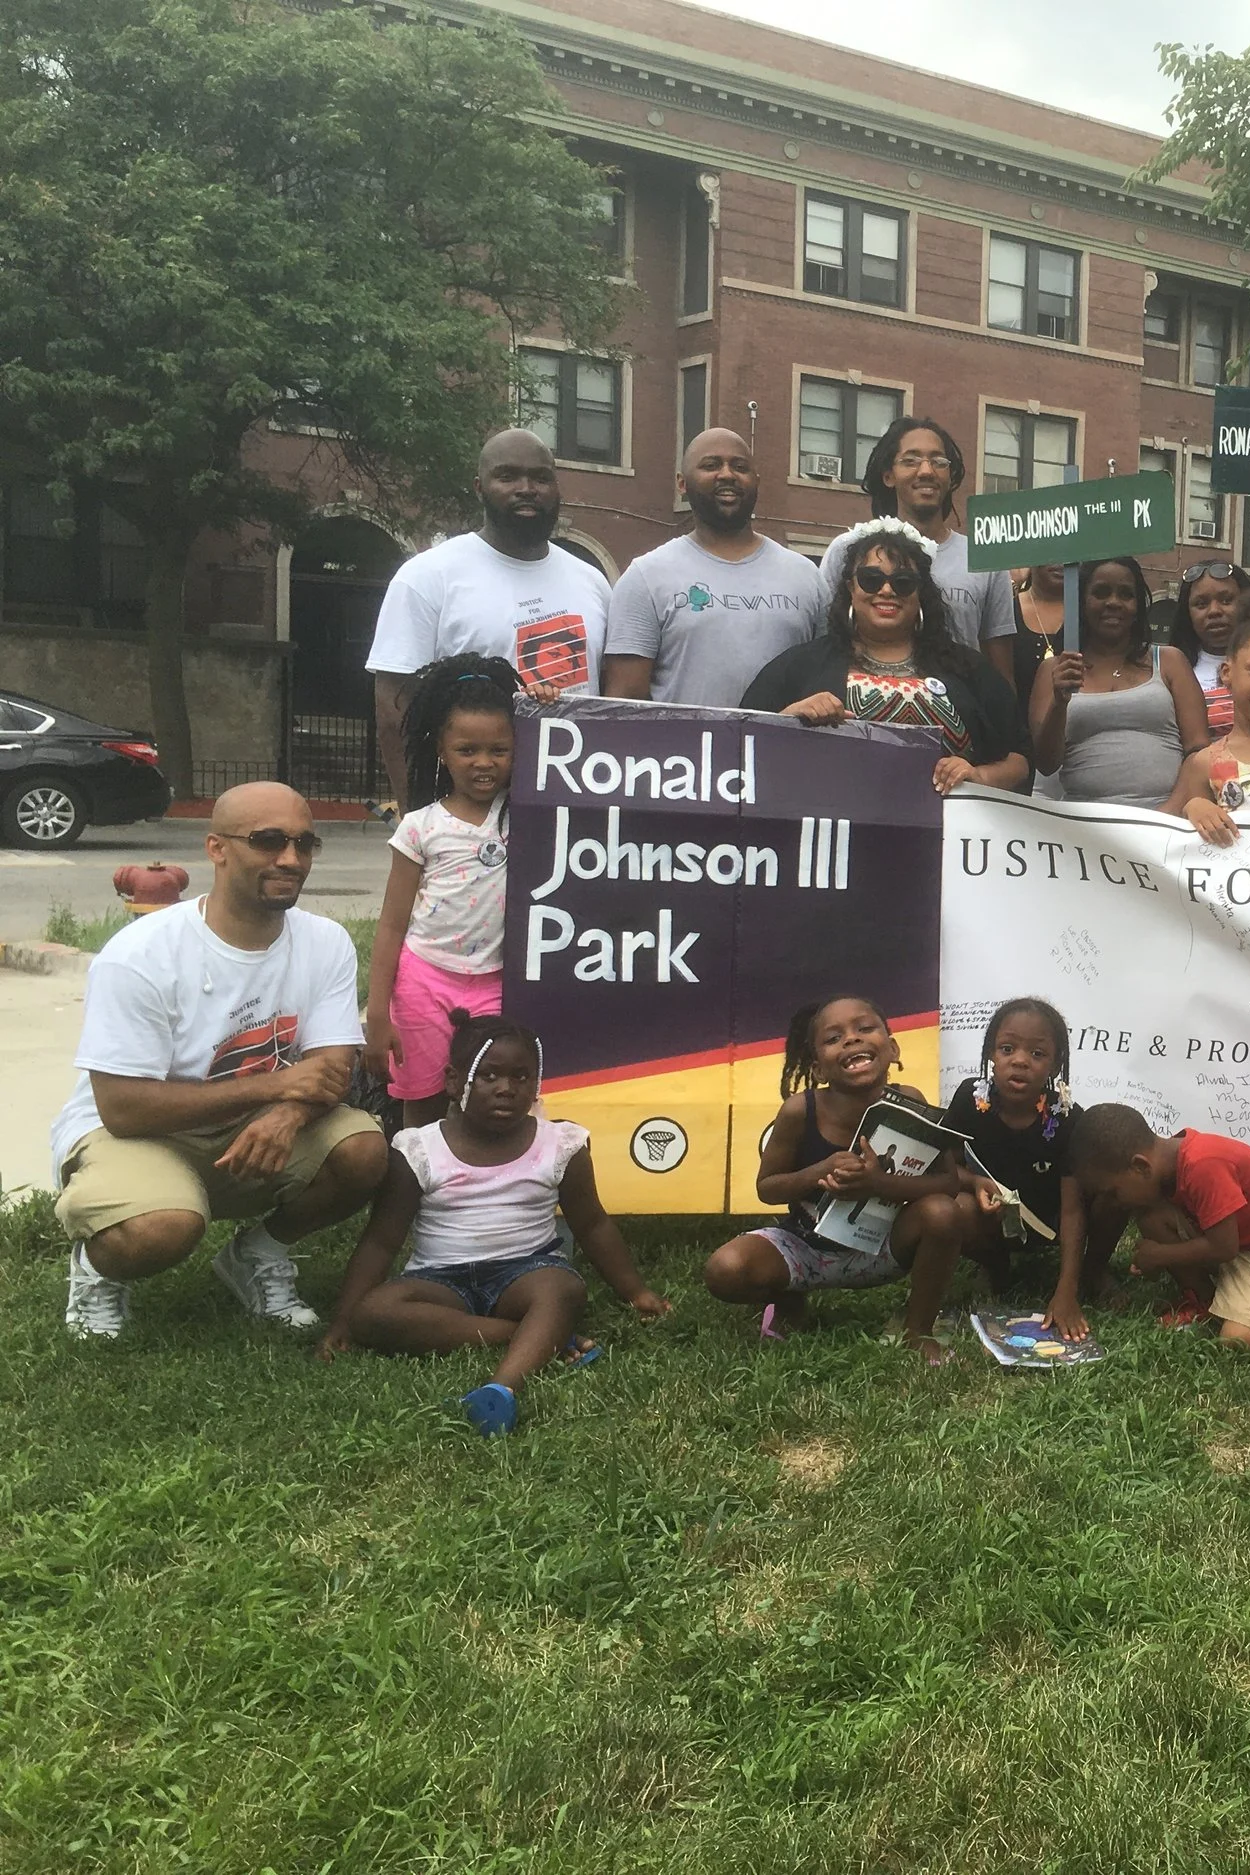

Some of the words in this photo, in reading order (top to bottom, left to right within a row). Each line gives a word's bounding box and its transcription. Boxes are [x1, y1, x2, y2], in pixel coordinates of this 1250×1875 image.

[974, 514, 1024, 545] RONALD
[1024, 505, 1079, 540] JOHNSON
[1084, 502, 1107, 515] THE
[1110, 499, 1121, 513] III
[1133, 498, 1151, 529] PK
[536, 717, 755, 804] Ronald
[530, 805, 779, 900] Johnson
[798, 817, 850, 889] III
[960, 838, 1159, 892] USTICE
[525, 904, 700, 983] Park
[229, 997, 261, 1019] JUSTICE
[239, 1012, 254, 1024] FOR
[1067, 1027, 1132, 1053] IRE
[1149, 1035, 1167, 1057] &
